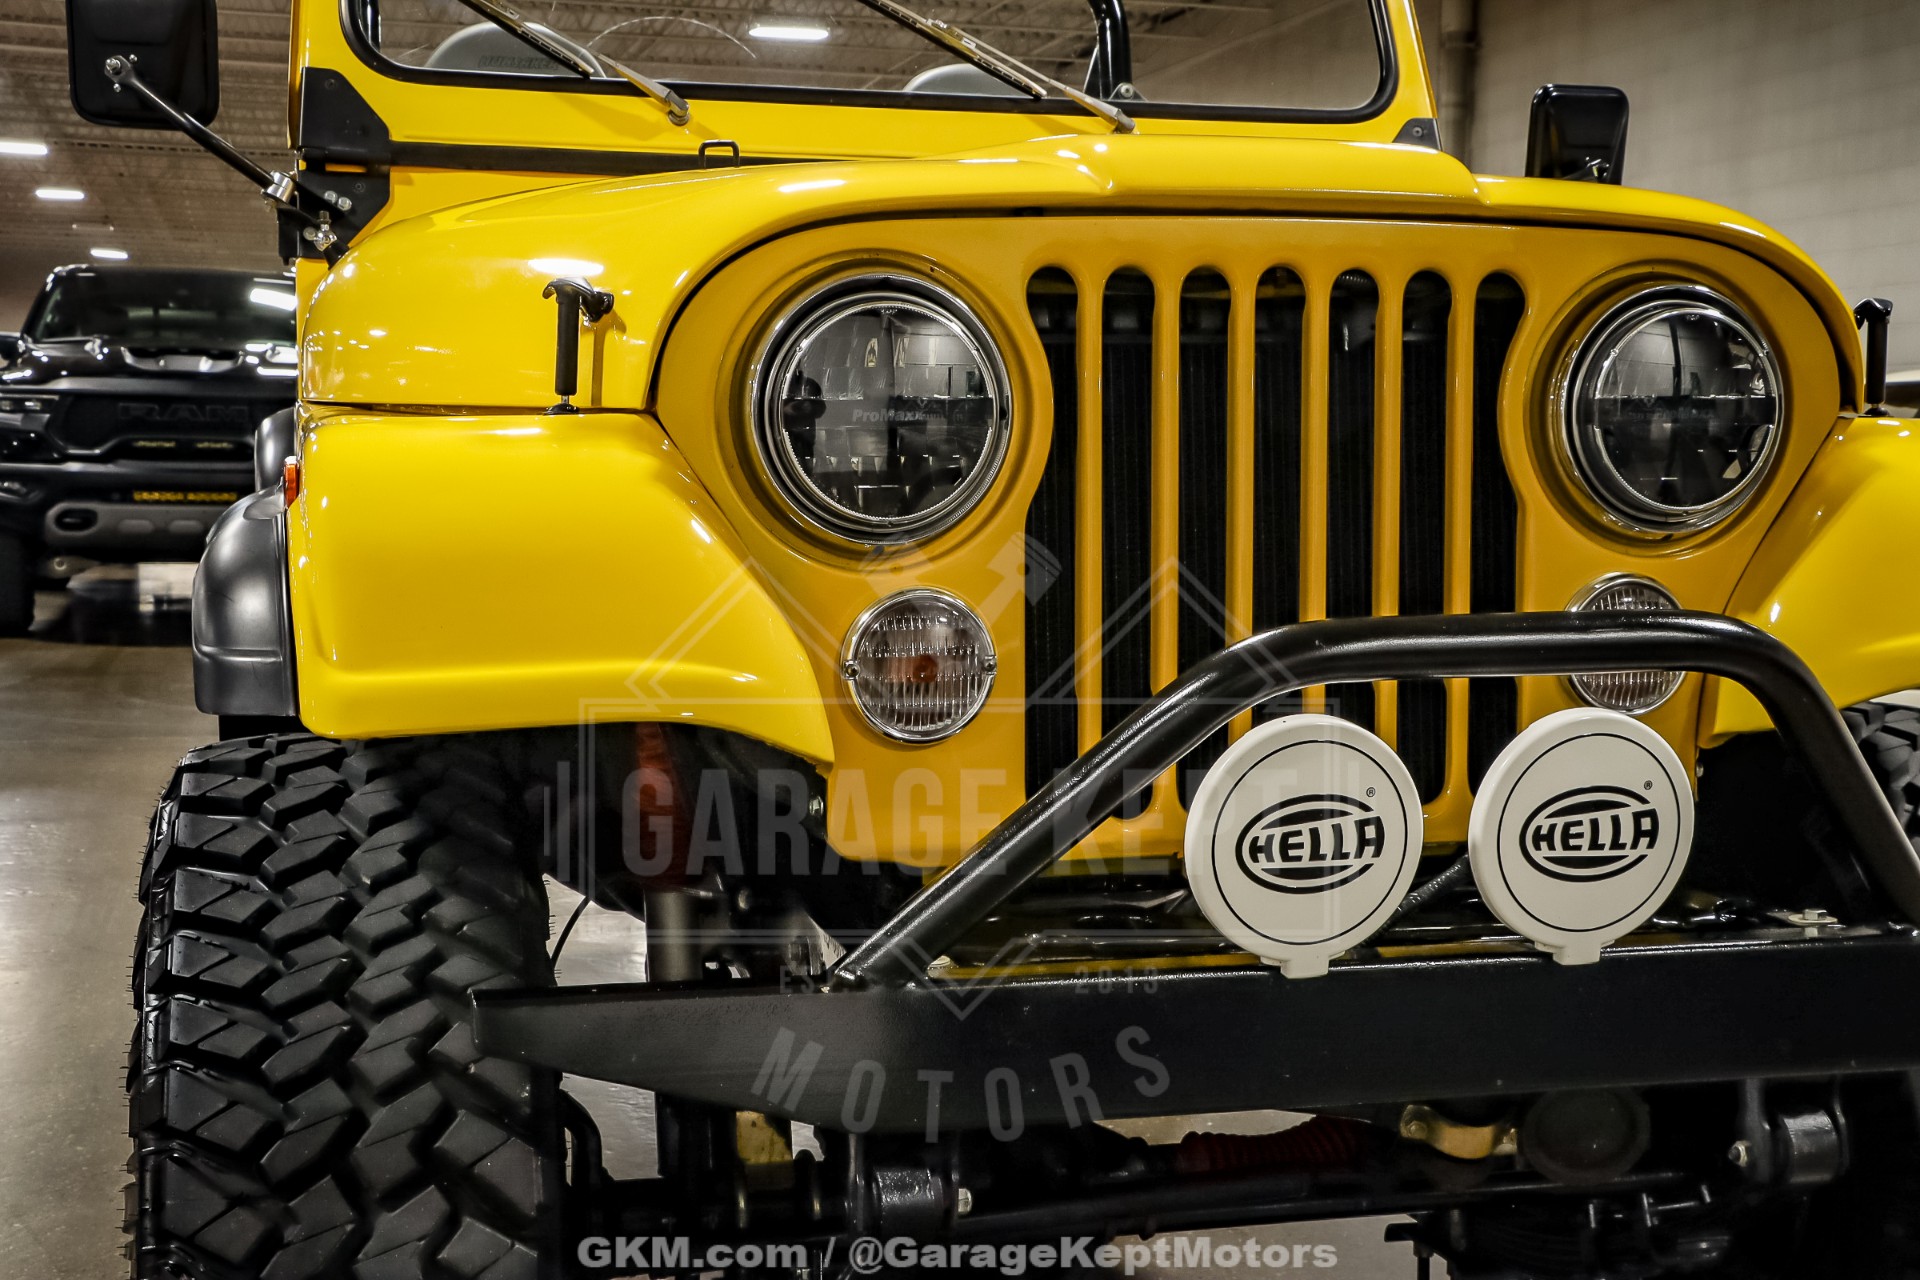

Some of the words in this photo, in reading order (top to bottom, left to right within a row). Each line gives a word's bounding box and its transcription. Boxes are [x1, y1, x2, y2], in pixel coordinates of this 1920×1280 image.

[118, 402, 249, 422] RAM
[1248, 815, 1386, 864] HELLA
[1530, 807, 1660, 854] HELLA
